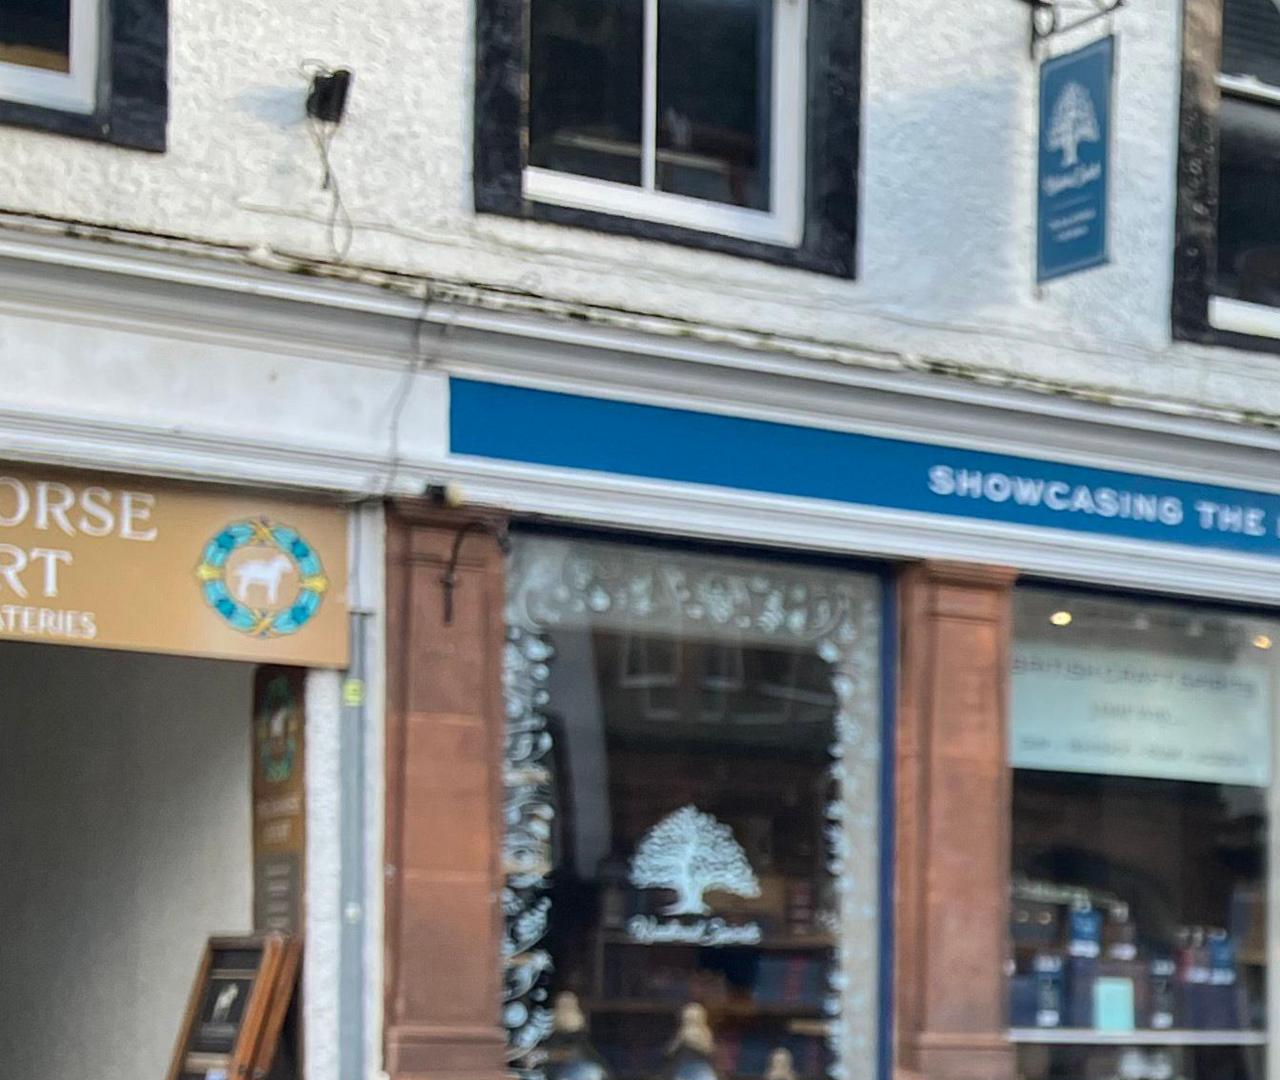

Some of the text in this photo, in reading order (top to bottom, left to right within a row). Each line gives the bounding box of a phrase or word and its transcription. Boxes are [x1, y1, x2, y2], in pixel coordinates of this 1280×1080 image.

[928, 464, 1184, 526] SHOWCASING
[1195, 500, 1266, 537] THE
[0, 604, 97, 639] TERIES
